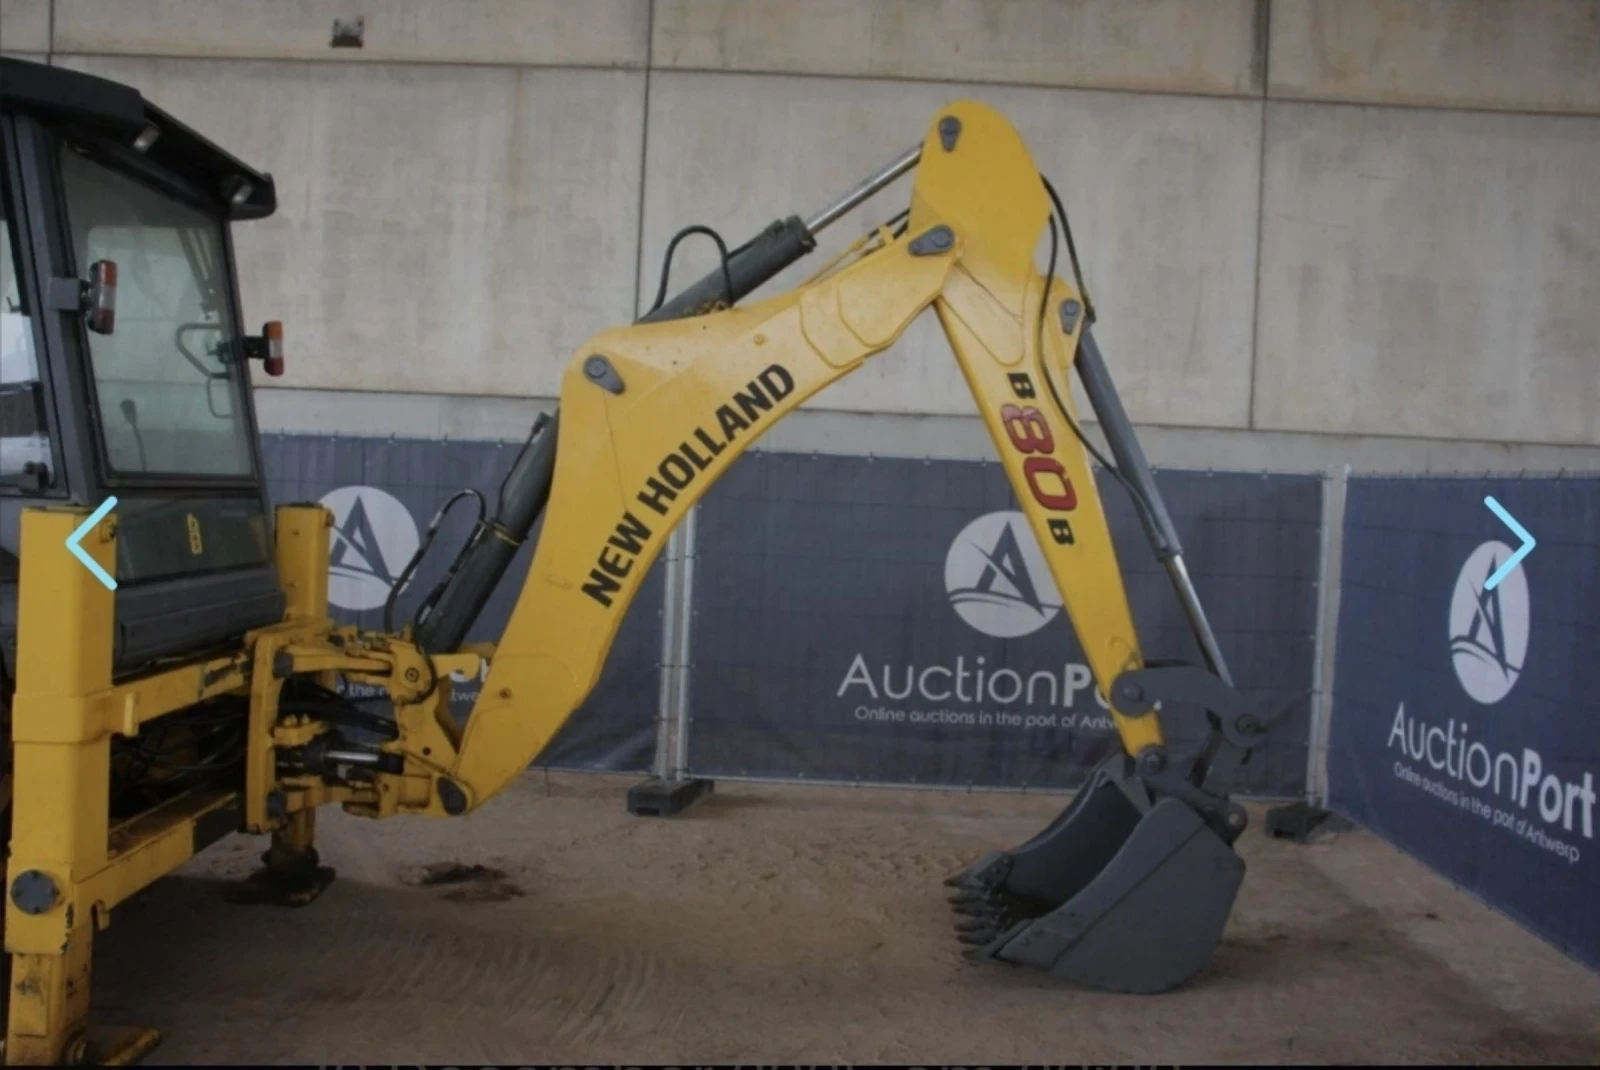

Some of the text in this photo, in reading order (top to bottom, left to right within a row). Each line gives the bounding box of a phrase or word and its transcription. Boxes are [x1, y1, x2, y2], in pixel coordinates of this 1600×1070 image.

[580, 363, 795, 608] NEW HOLLAND
[837, 653, 1161, 711] AuctionP
[855, 705, 905, 721] Online
[910, 707, 975, 725] auctions
[979, 709, 993, 725] in
[996, 709, 1021, 727] the
[1025, 711, 1056, 729] port
[1061, 712, 1076, 728] of
[1387, 701, 1596, 839] AuctionPort
[1394, 761, 1580, 865] Online auctions in the port of Antwerp
